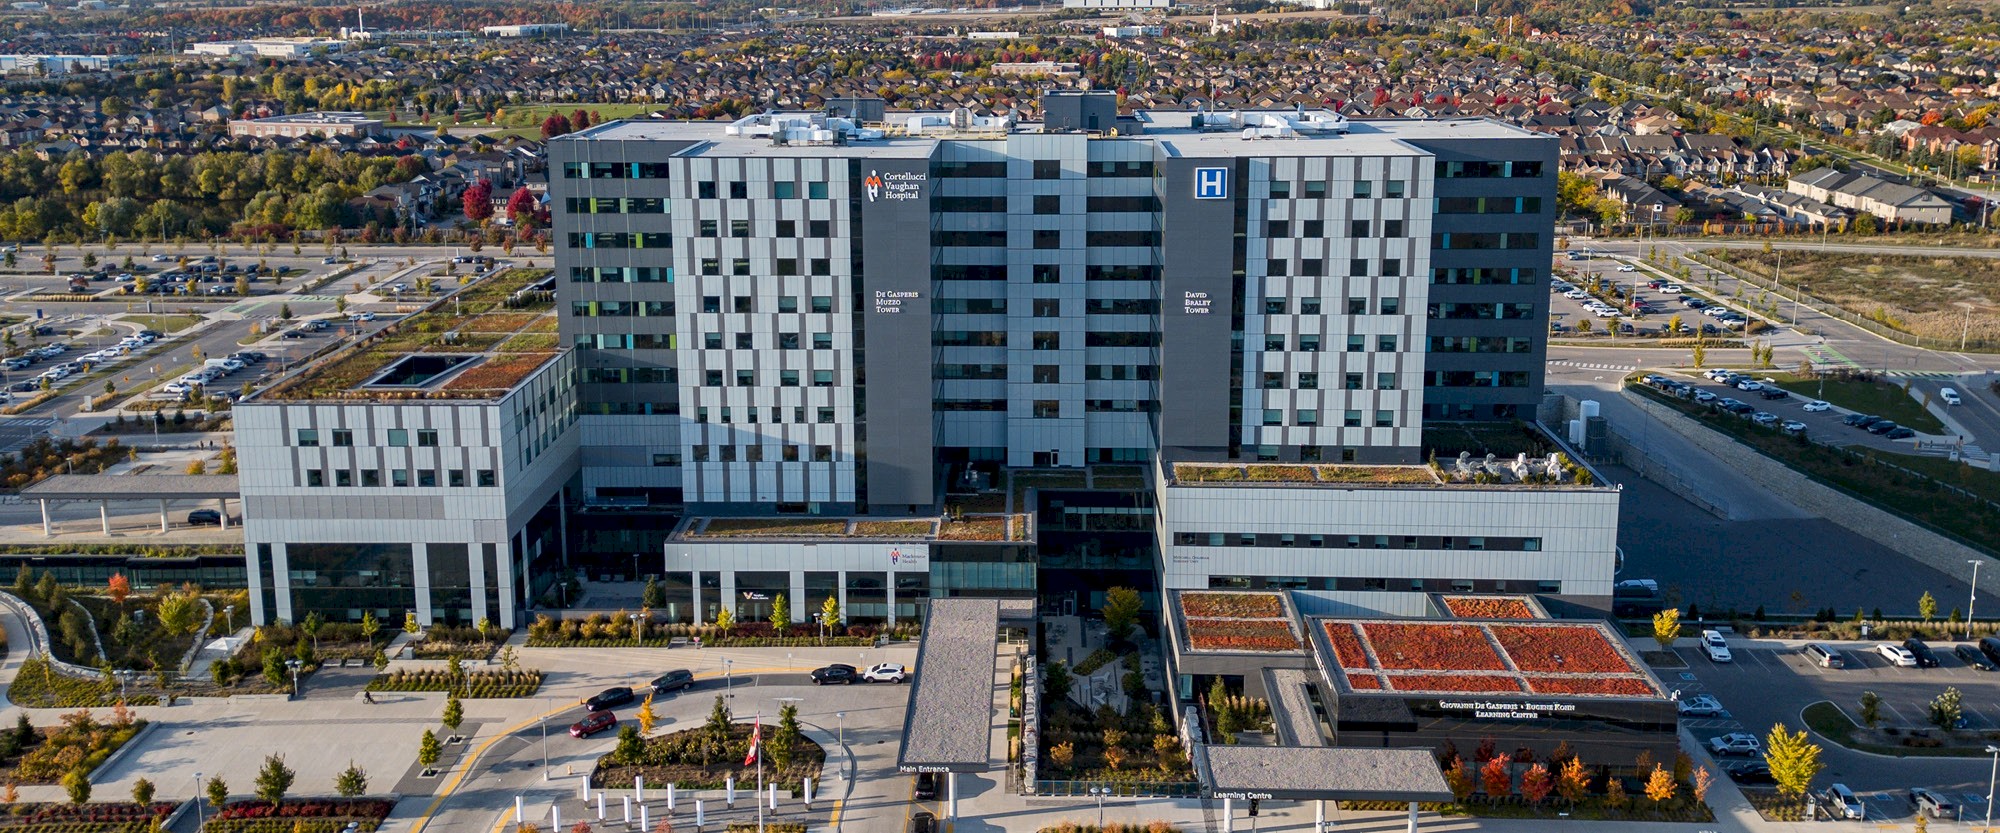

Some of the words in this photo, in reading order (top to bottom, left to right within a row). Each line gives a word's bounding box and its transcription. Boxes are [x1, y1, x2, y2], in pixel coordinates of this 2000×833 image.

[884, 172, 926, 180] Cortellucci
[885, 182, 920, 192] Vaughan
[1201, 171, 1222, 196] H
[885, 191, 919, 201] Hospital
[1439, 701, 1474, 709] GIOVANNI
[1485, 702, 1518, 710] GASPERIS
[1511, 711, 1538, 719] CENTRE
[900, 765, 917, 773] Main
[918, 765, 950, 773] Entrance
[1213, 791, 1246, 801] Learning
[1247, 791, 1273, 800] Centre
